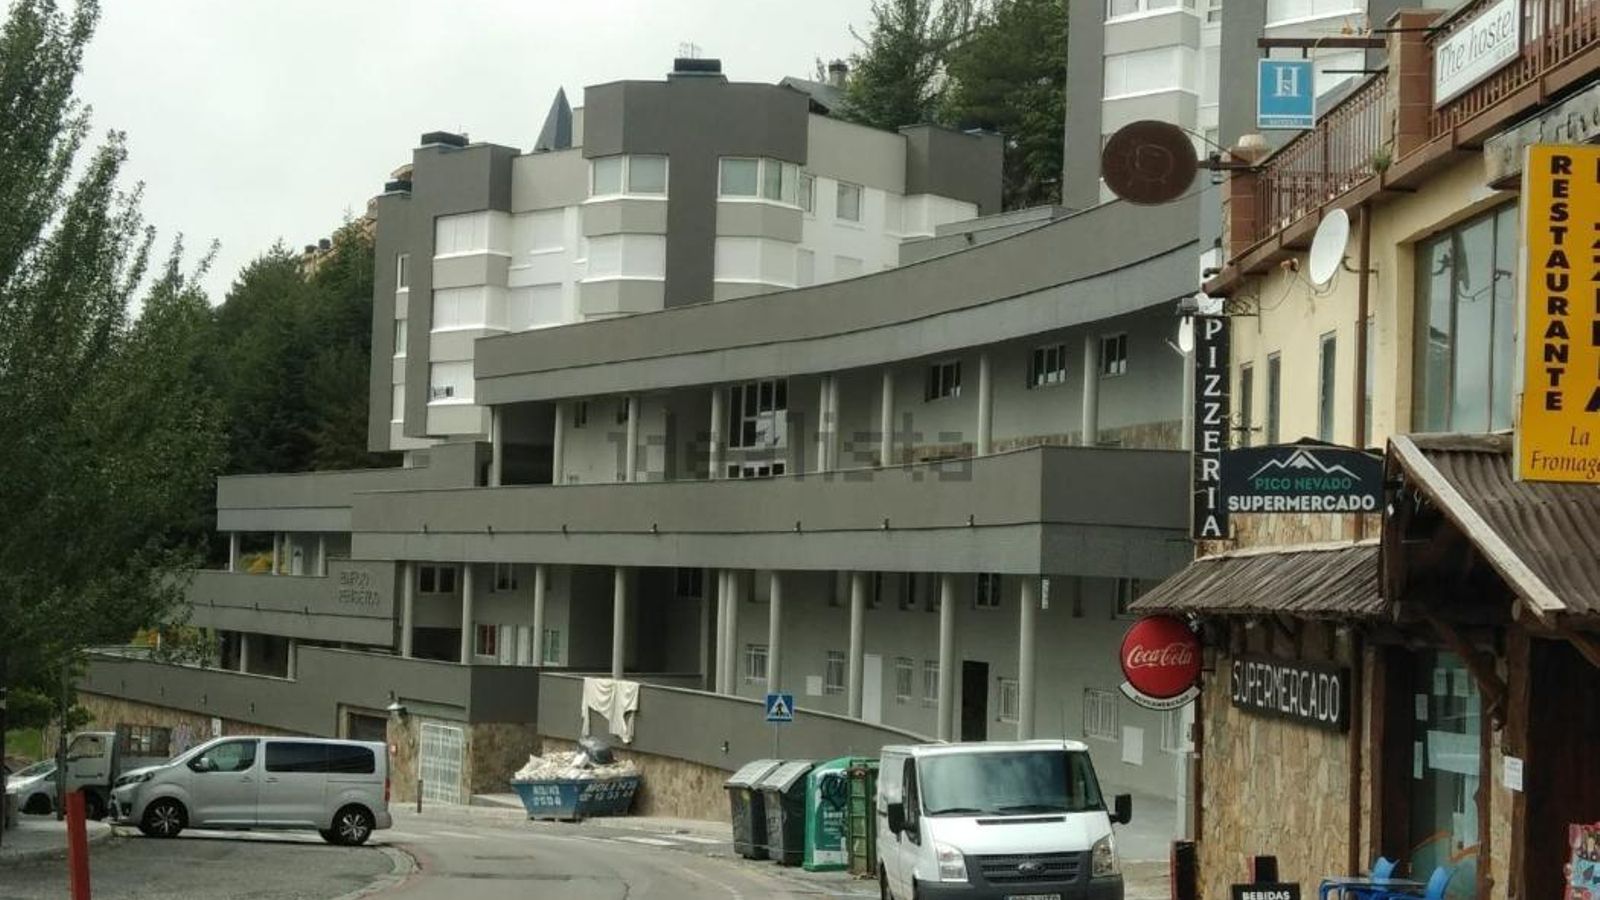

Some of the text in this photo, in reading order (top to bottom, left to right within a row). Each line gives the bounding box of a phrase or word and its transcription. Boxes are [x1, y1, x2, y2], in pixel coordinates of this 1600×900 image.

[1439, 44, 1464, 82] The
[1468, 2, 1515, 61] hostel
[1545, 155, 1572, 411] RESTAURANTE
[1202, 319, 1223, 537] PIZZERIA
[1569, 426, 1590, 446] La
[1254, 477, 1352, 490] PICO NEVADO
[1228, 495, 1375, 511] SUPERMERCADO
[1127, 642, 1193, 669] Coca-Cola
[1233, 660, 1340, 723] SUPERMERCADO
[1242, 891, 1290, 900] BEBIDAS
